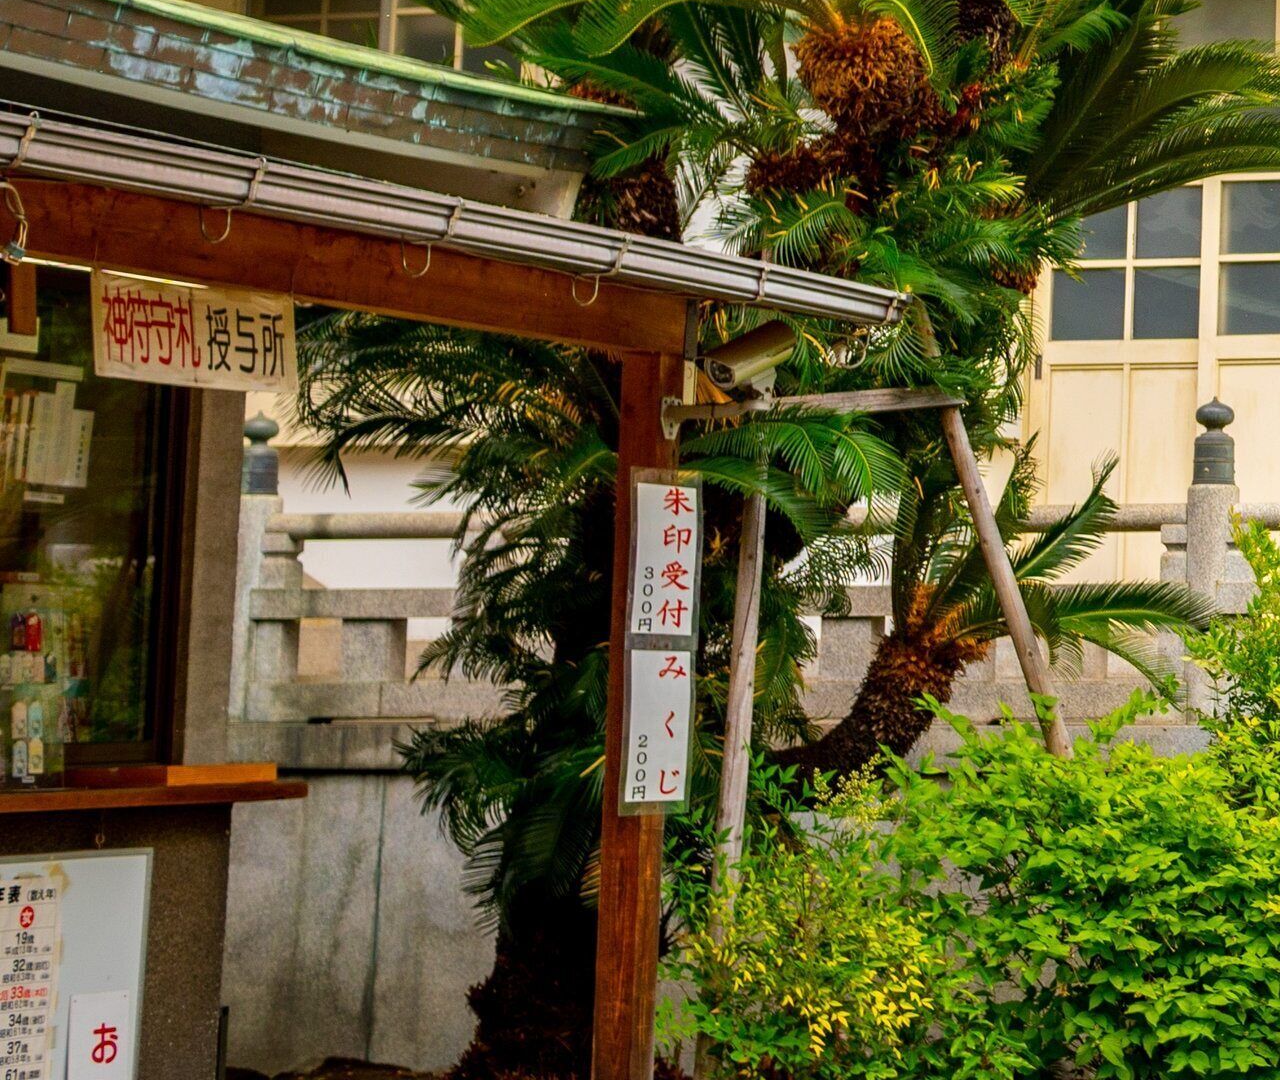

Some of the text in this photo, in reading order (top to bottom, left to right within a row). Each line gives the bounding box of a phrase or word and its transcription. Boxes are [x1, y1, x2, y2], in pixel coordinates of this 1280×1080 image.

[656, 488, 694, 628] 朱印受付
[638, 567, 654, 632] 300円
[658, 655, 687, 794] みくじ
[631, 735, 649, 799] 200円
[91, 1022, 118, 1063] お
